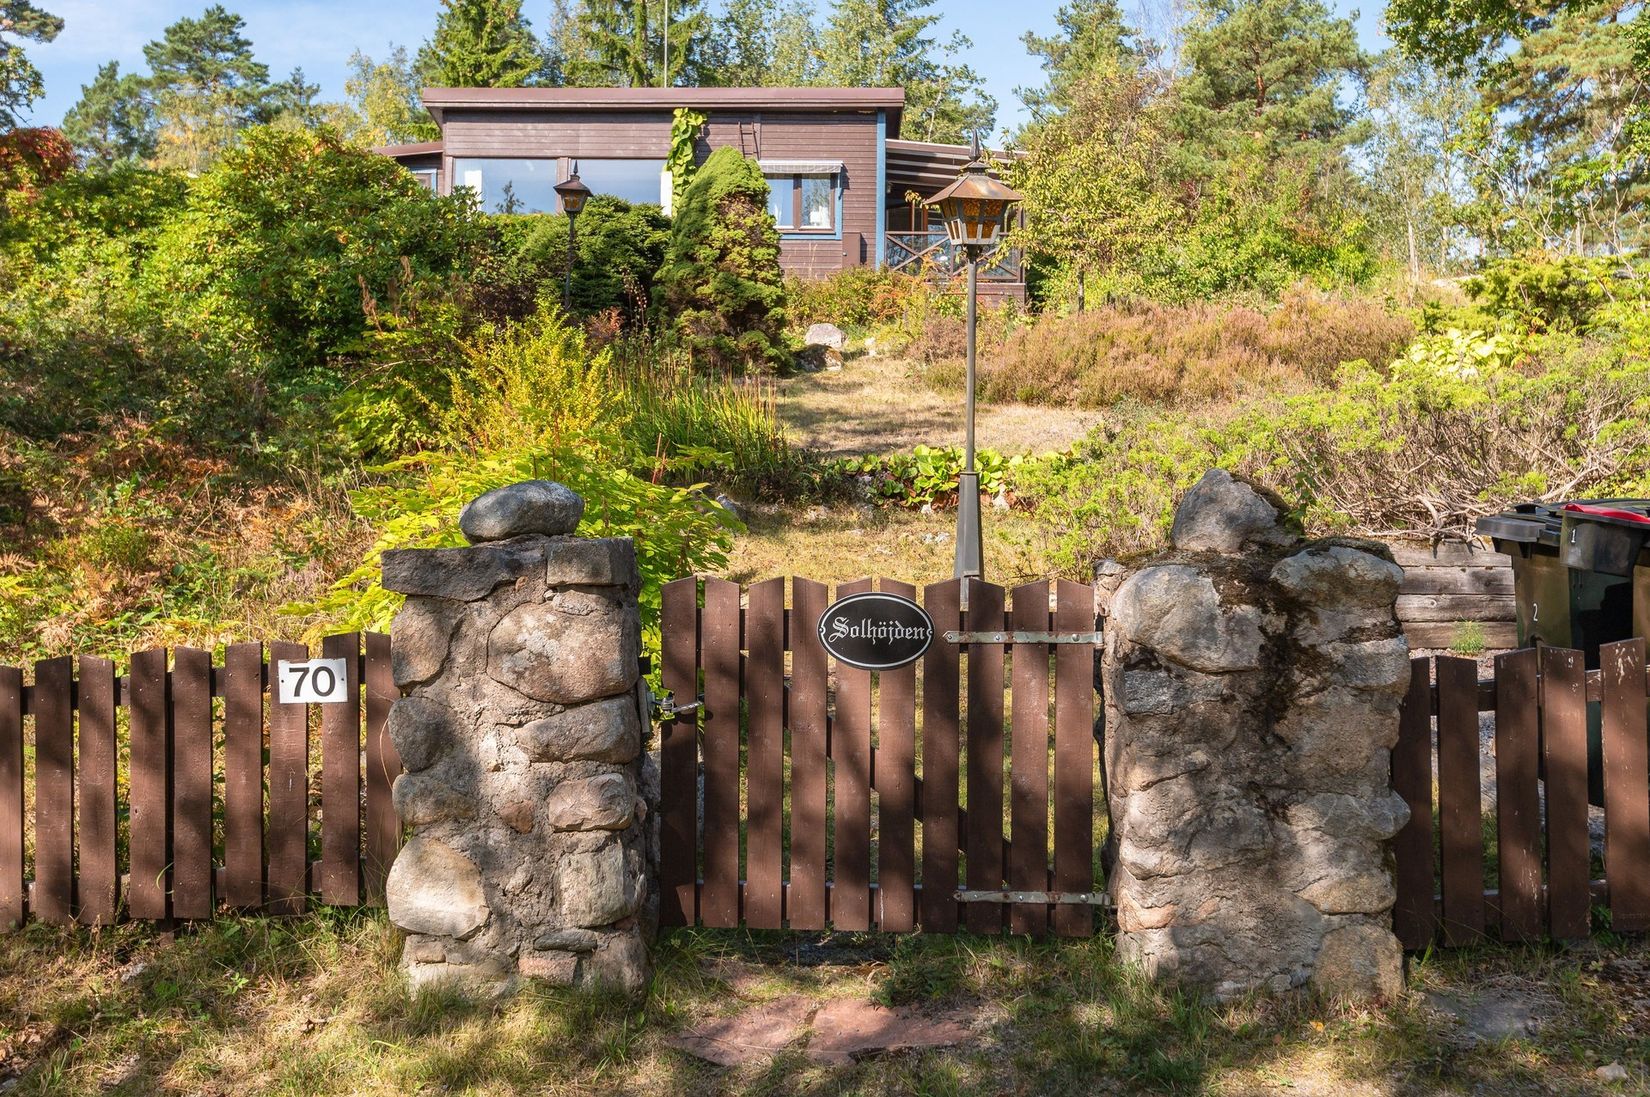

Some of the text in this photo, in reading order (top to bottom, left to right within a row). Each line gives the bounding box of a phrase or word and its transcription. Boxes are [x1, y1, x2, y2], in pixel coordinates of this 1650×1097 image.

[1570, 528, 1577, 543] 1
[1532, 603, 1539, 622] 2
[828, 616, 925, 645] Solhöjden
[289, 666, 336, 697] 70
